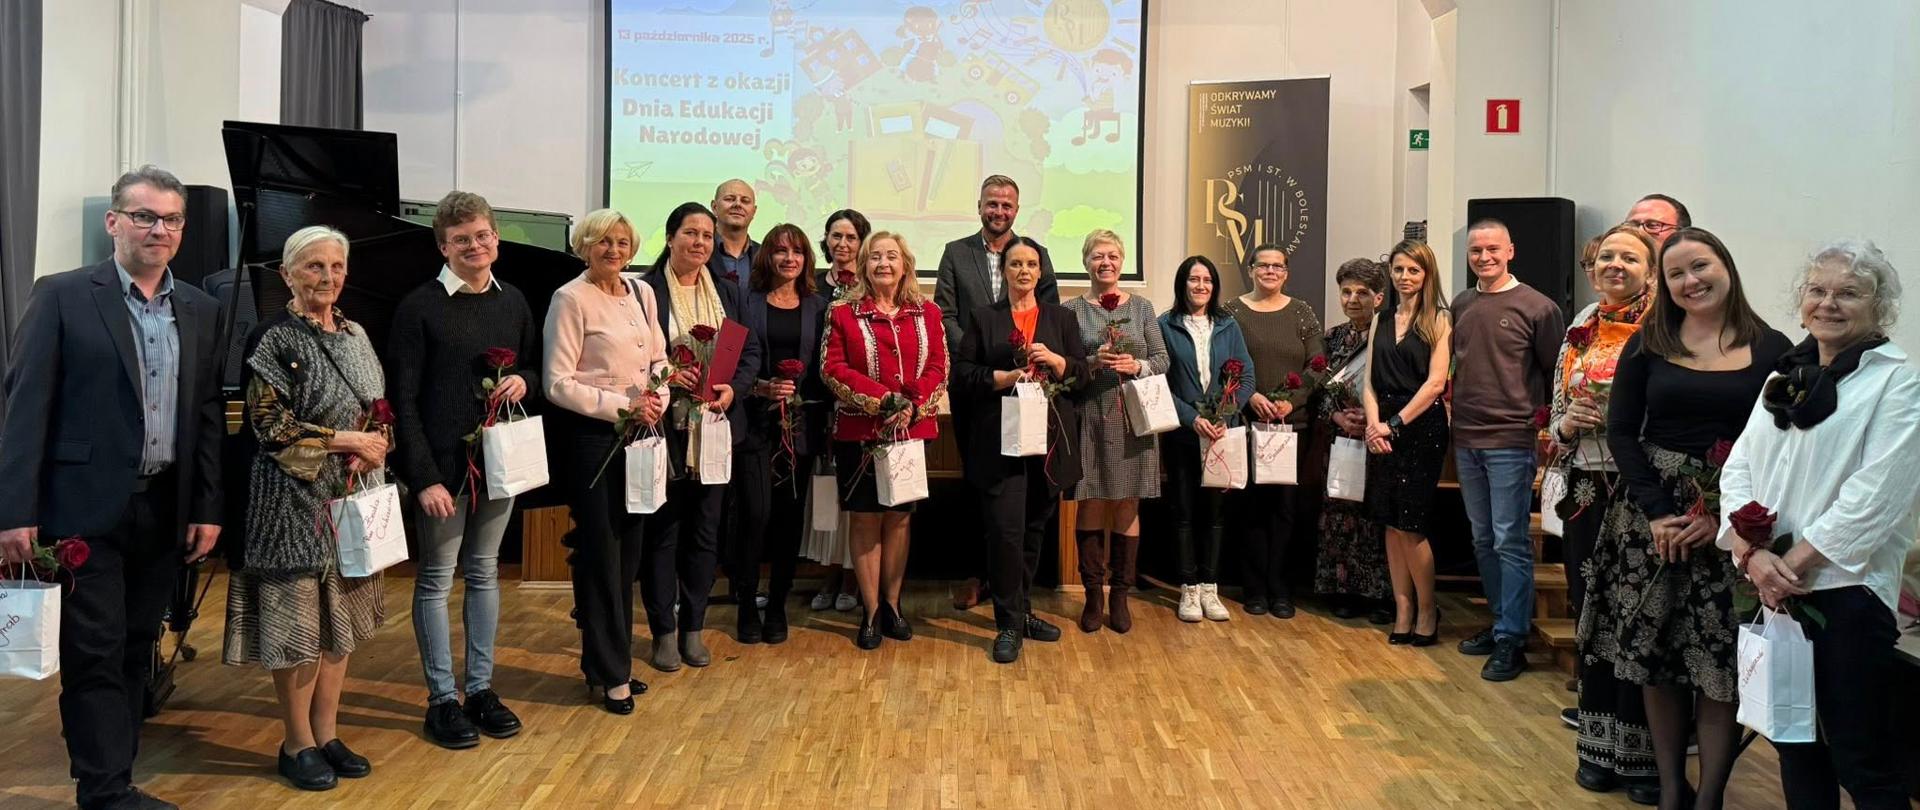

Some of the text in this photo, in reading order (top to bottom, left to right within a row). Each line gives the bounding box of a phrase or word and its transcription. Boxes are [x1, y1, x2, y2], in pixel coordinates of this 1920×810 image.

[723, 33, 754, 44] 2025
[614, 67, 790, 94] Koncert z okazji
[1210, 89, 1277, 102] ODKRYWAMY
[622, 98, 773, 124] Dnia Edukacji
[1210, 104, 1242, 115] ŚWIAT
[639, 125, 761, 150] Narodowej
[1227, 164, 1253, 179] PSM
[1266, 165, 1282, 178] ST.
[1286, 176, 1297, 188] W
[1286, 190, 1309, 255] BOLESŁAW
